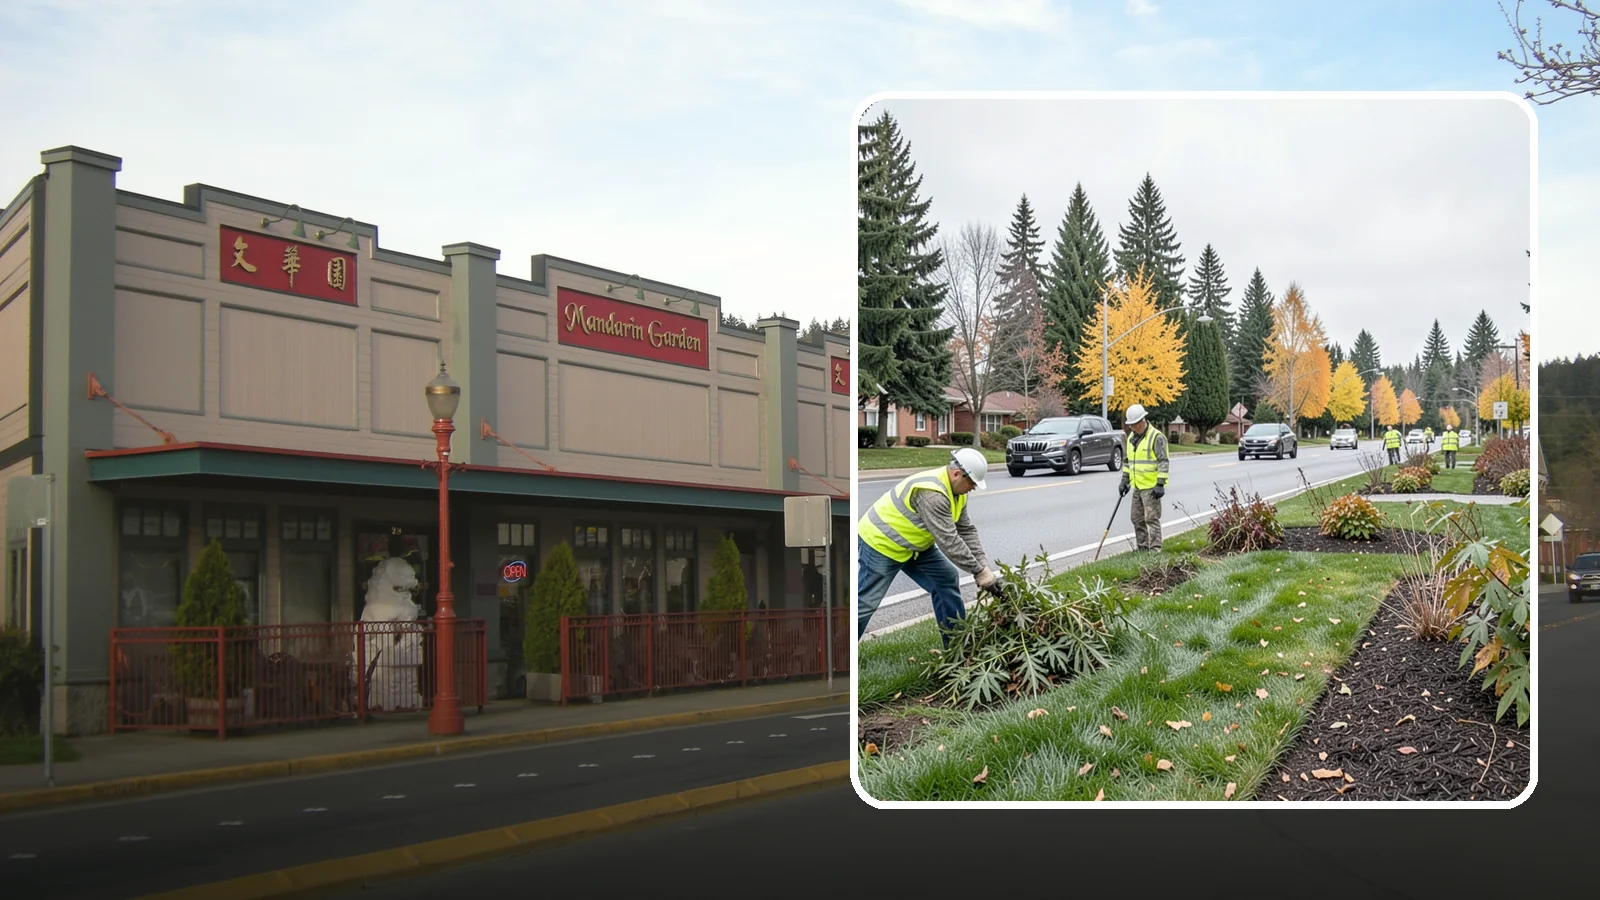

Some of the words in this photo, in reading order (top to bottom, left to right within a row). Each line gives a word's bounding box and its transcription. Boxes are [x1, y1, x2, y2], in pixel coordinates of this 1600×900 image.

[231, 235, 346, 291] 文華園
[564, 302, 644, 341] Mandarin
[647, 320, 702, 352] Garden
[834, 363, 846, 386] 文
[503, 565, 526, 578] OPEN
